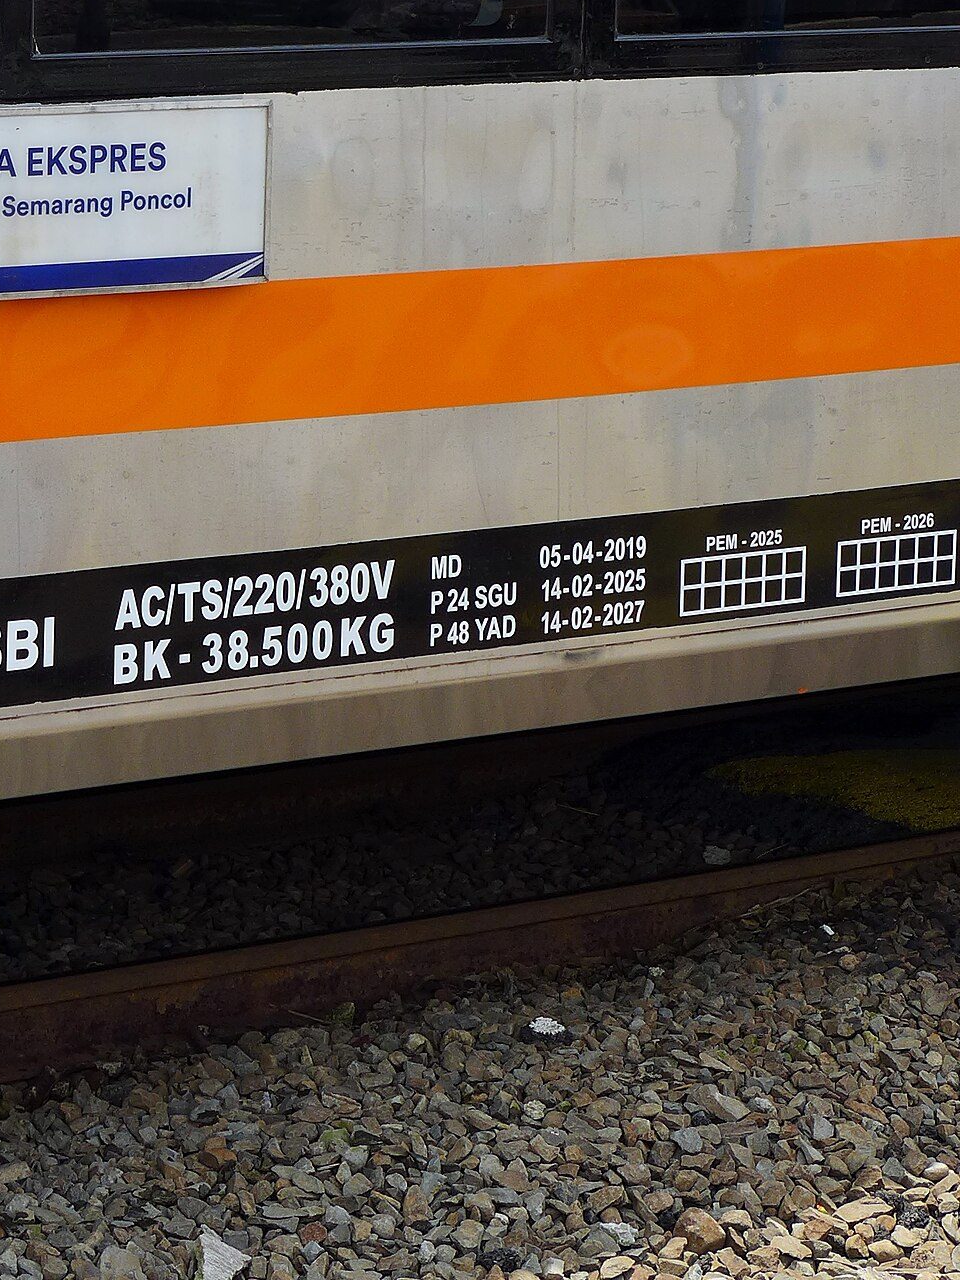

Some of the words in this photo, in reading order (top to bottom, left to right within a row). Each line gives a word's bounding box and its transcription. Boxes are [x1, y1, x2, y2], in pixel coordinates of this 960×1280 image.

[27, 141, 167, 177] EKSPRES
[1, 195, 113, 218] Semarang
[120, 186, 192, 212] Poncol
[705, 533, 738, 552] PEM
[749, 528, 783, 548] 2025
[861, 516, 892, 535] PEM
[902, 512, 935, 531] 2026
[431, 554, 462, 580] MD
[539, 535, 647, 569] 05-04-2019
[114, 559, 396, 631] AC/TS/220/380V
[474, 581, 517, 609] SGU
[541, 567, 646, 602] 14-02-2025
[474, 614, 516, 641] YAD
[541, 599, 645, 635] 14-02-2027
[113, 638, 172, 685] BK
